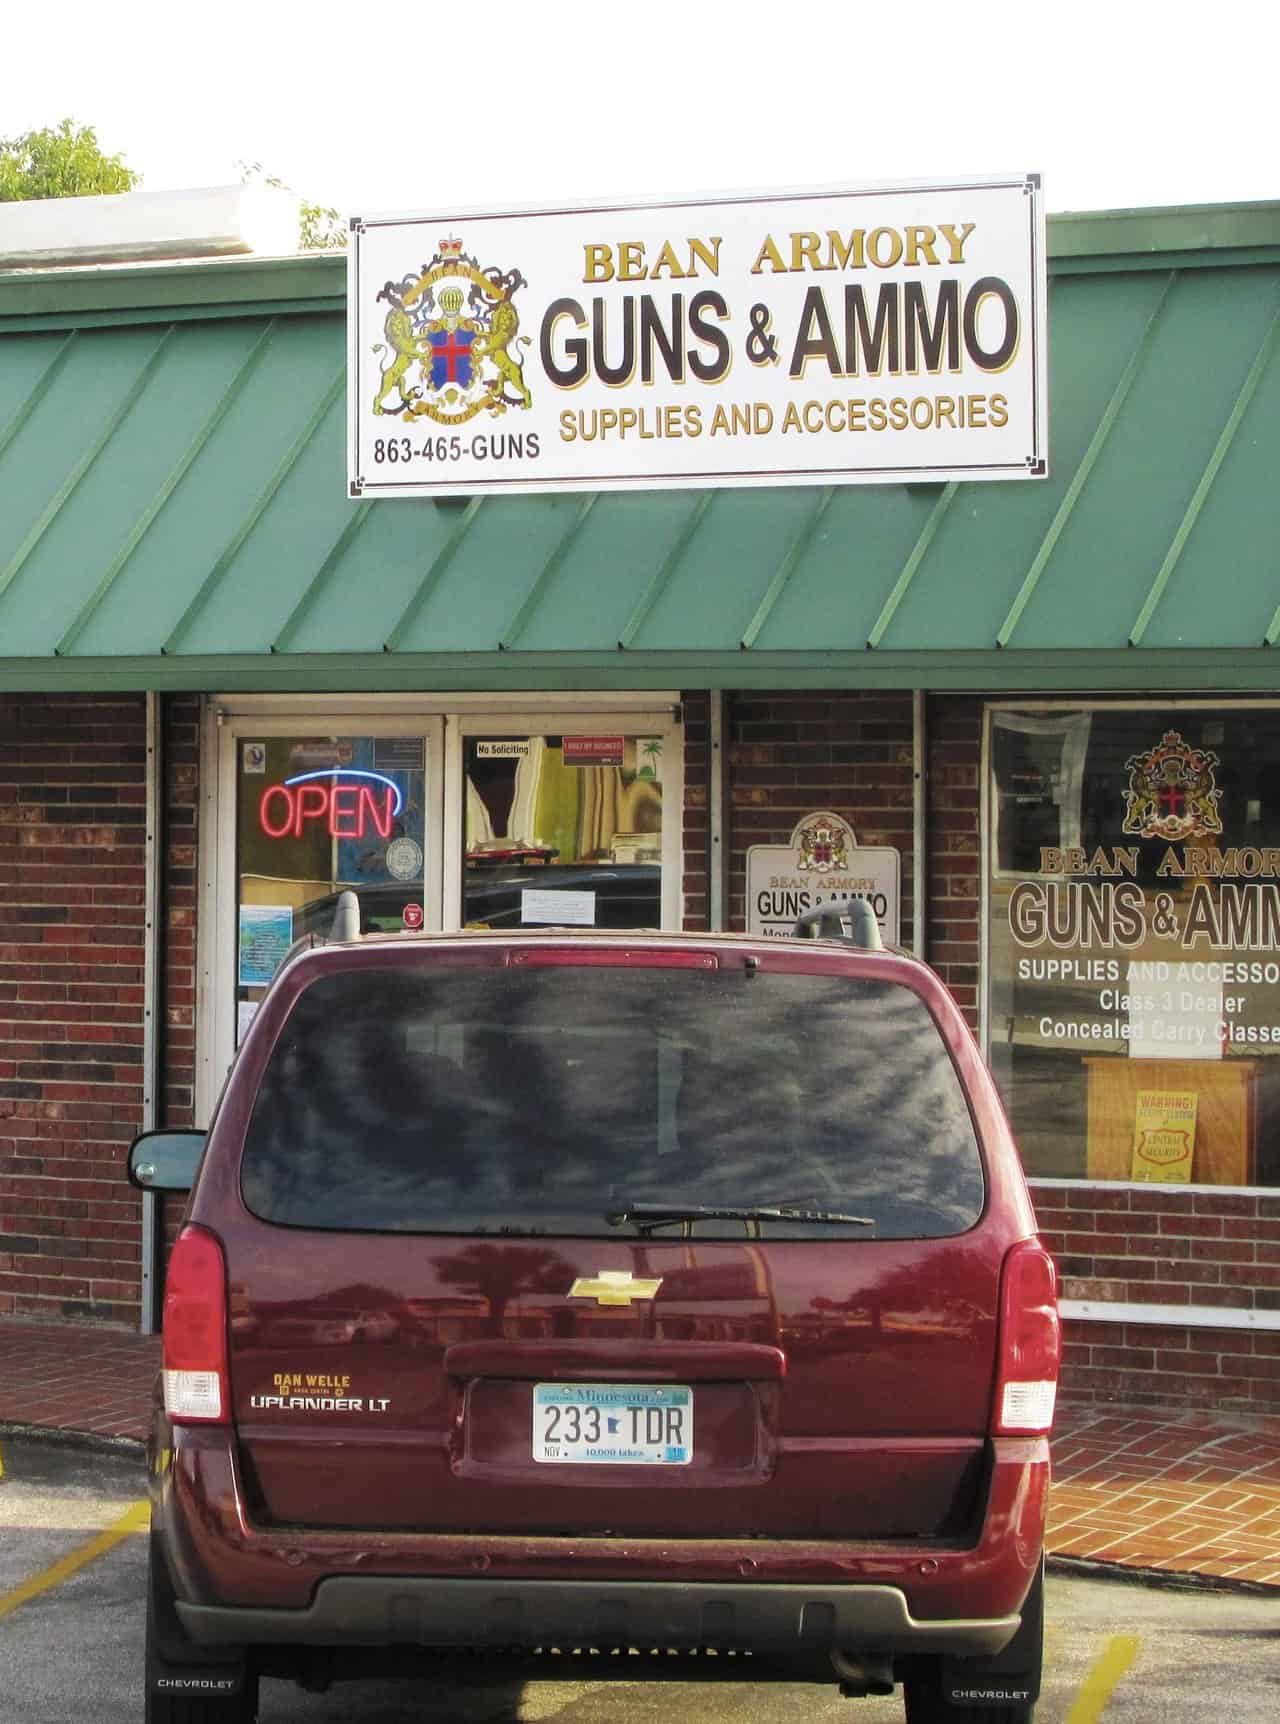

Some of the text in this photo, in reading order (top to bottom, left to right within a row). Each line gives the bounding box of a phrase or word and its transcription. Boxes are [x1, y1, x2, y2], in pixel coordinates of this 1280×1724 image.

[583, 223, 976, 283] BEAN ARMORY
[539, 277, 1021, 388] GUNS & AMMO
[559, 394, 1010, 442] SUPPLIES AND ACCESSORIES
[373, 432, 540, 464] 863-465-GUNS
[478, 743, 529, 756] No Soliciting
[260, 784, 394, 838] OPEN
[1039, 846, 1140, 877] BEAN
[769, 877, 878, 890] BEAN ARMORY
[758, 890, 810, 917] GUNS
[1009, 881, 1146, 949] GUNS
[1152, 892, 1180, 941] &
[1018, 959, 1120, 982] SUPPLIES
[1125, 960, 1170, 982] AND
[1099, 989, 1246, 1013] Class 3 Dealer
[1039, 1016, 1145, 1040] Concealed
[1151, 1020, 1205, 1046] Carry
[273, 1374, 350, 1388] DAN WELLE
[250, 1396, 391, 1412] UPLANDER LT
[577, 1389, 649, 1403] Minnesota
[544, 1406, 683, 1445] 233 TDR
[544, 1447, 561, 1457] NOV
[586, 1448, 616, 1458] 10,000
[618, 1448, 645, 1457] lakes
[158, 1679, 234, 1688] CHEVROLET
[952, 1689, 1029, 1699] CHEVROLET
